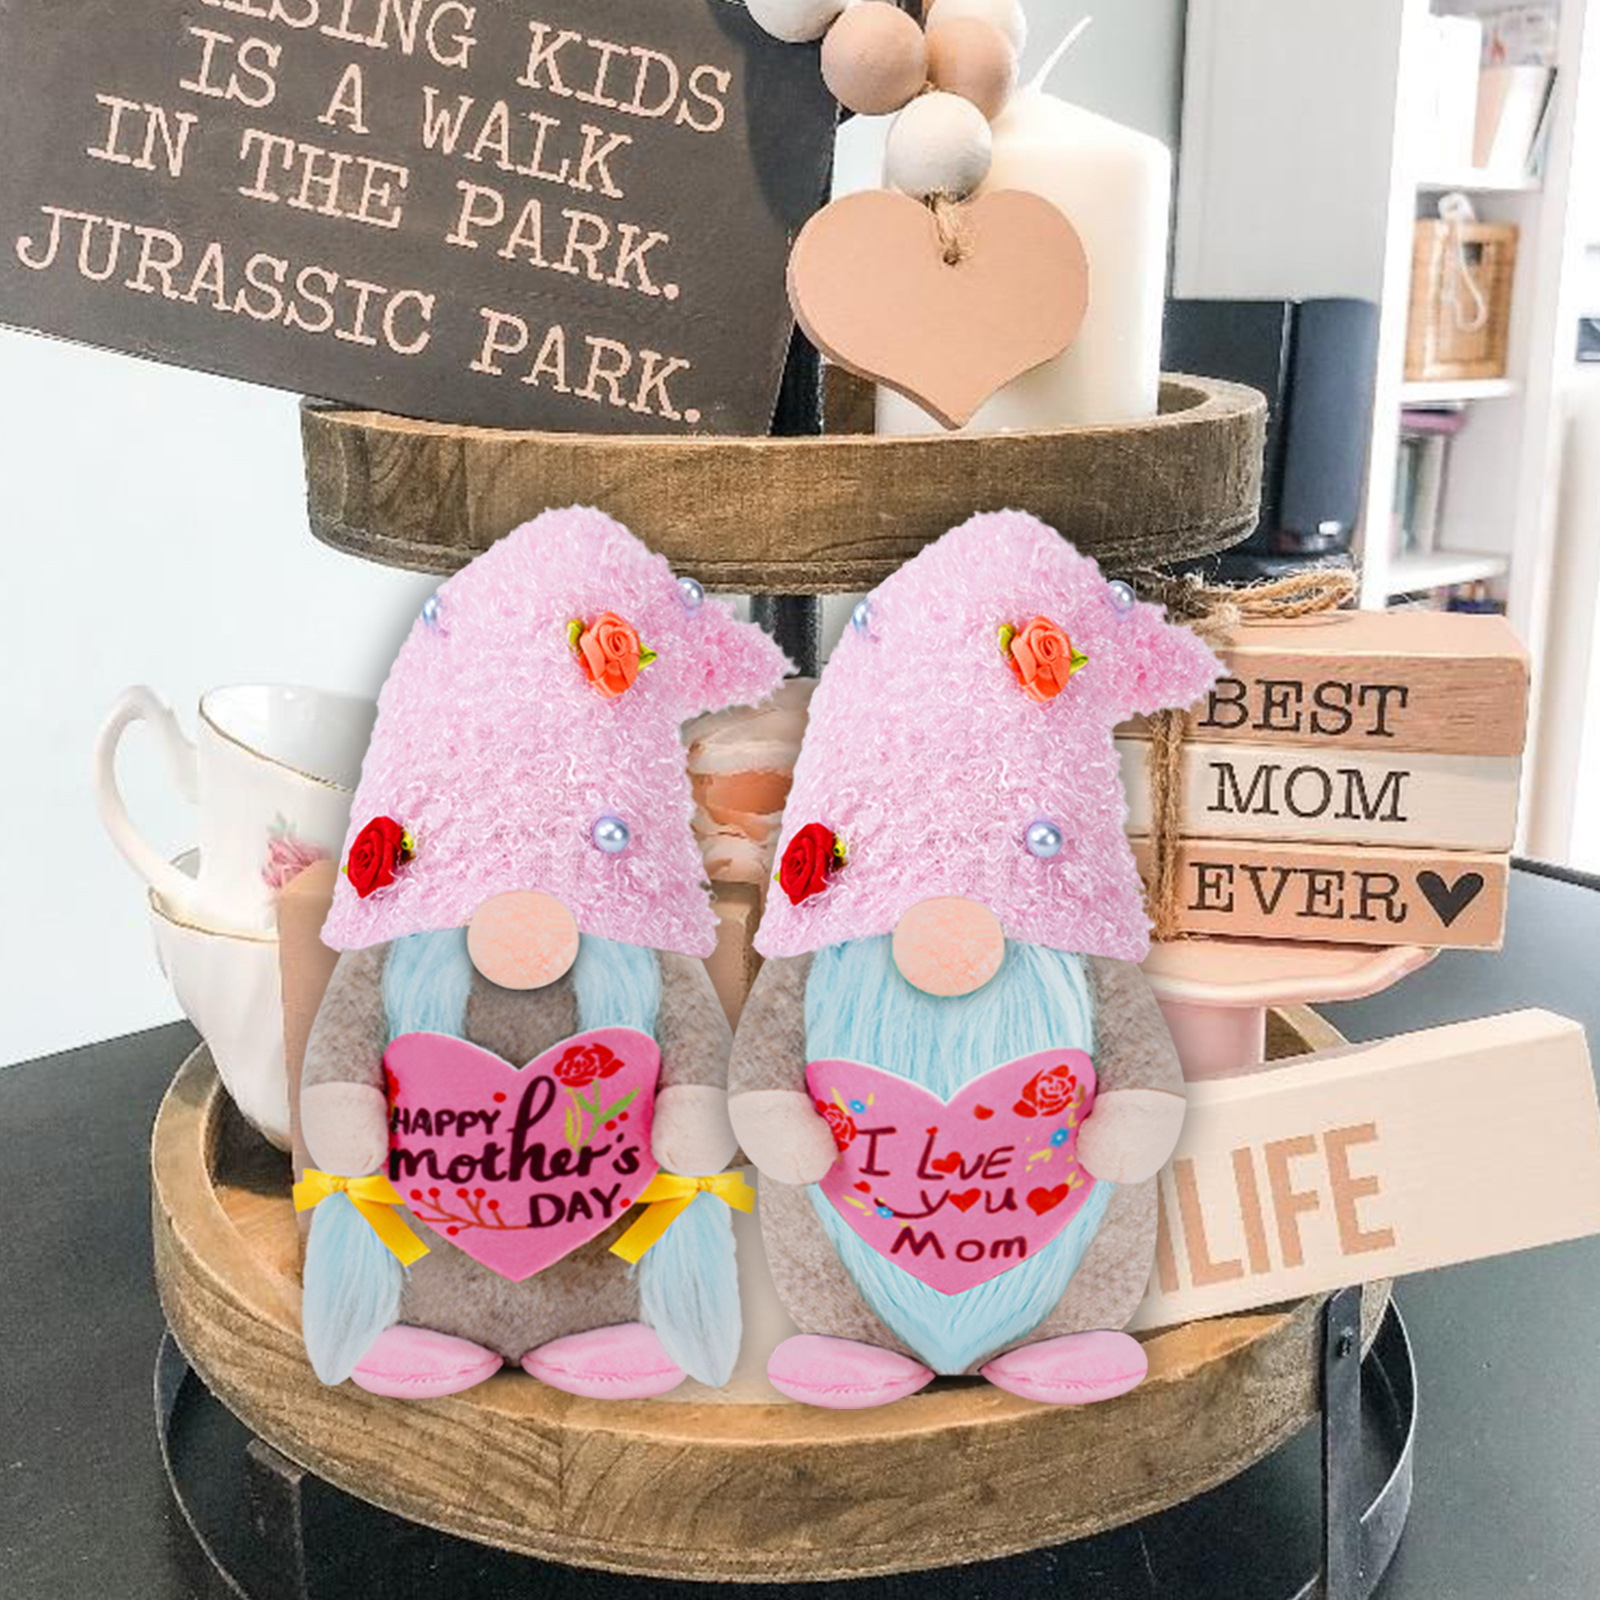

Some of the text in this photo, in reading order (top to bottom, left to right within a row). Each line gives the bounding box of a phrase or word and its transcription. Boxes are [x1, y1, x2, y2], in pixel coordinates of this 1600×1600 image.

[179, 26, 634, 200] IS A WALK
[516, 21, 732, 133] KIDS
[86, 93, 681, 301] IN THE PARK.
[15, 205, 701, 423] JURASSIC PARK.
[1198, 678, 1408, 737] BEST
[1206, 762, 1411, 822] MOM
[1187, 862, 1409, 924] EVER
[388, 1075, 641, 1184] mother's
[390, 1106, 501, 1137] HAPPY
[857, 1126, 897, 1176] I
[528, 1183, 622, 1228] DAY
[1145, 1122, 1395, 1297] LIFE
